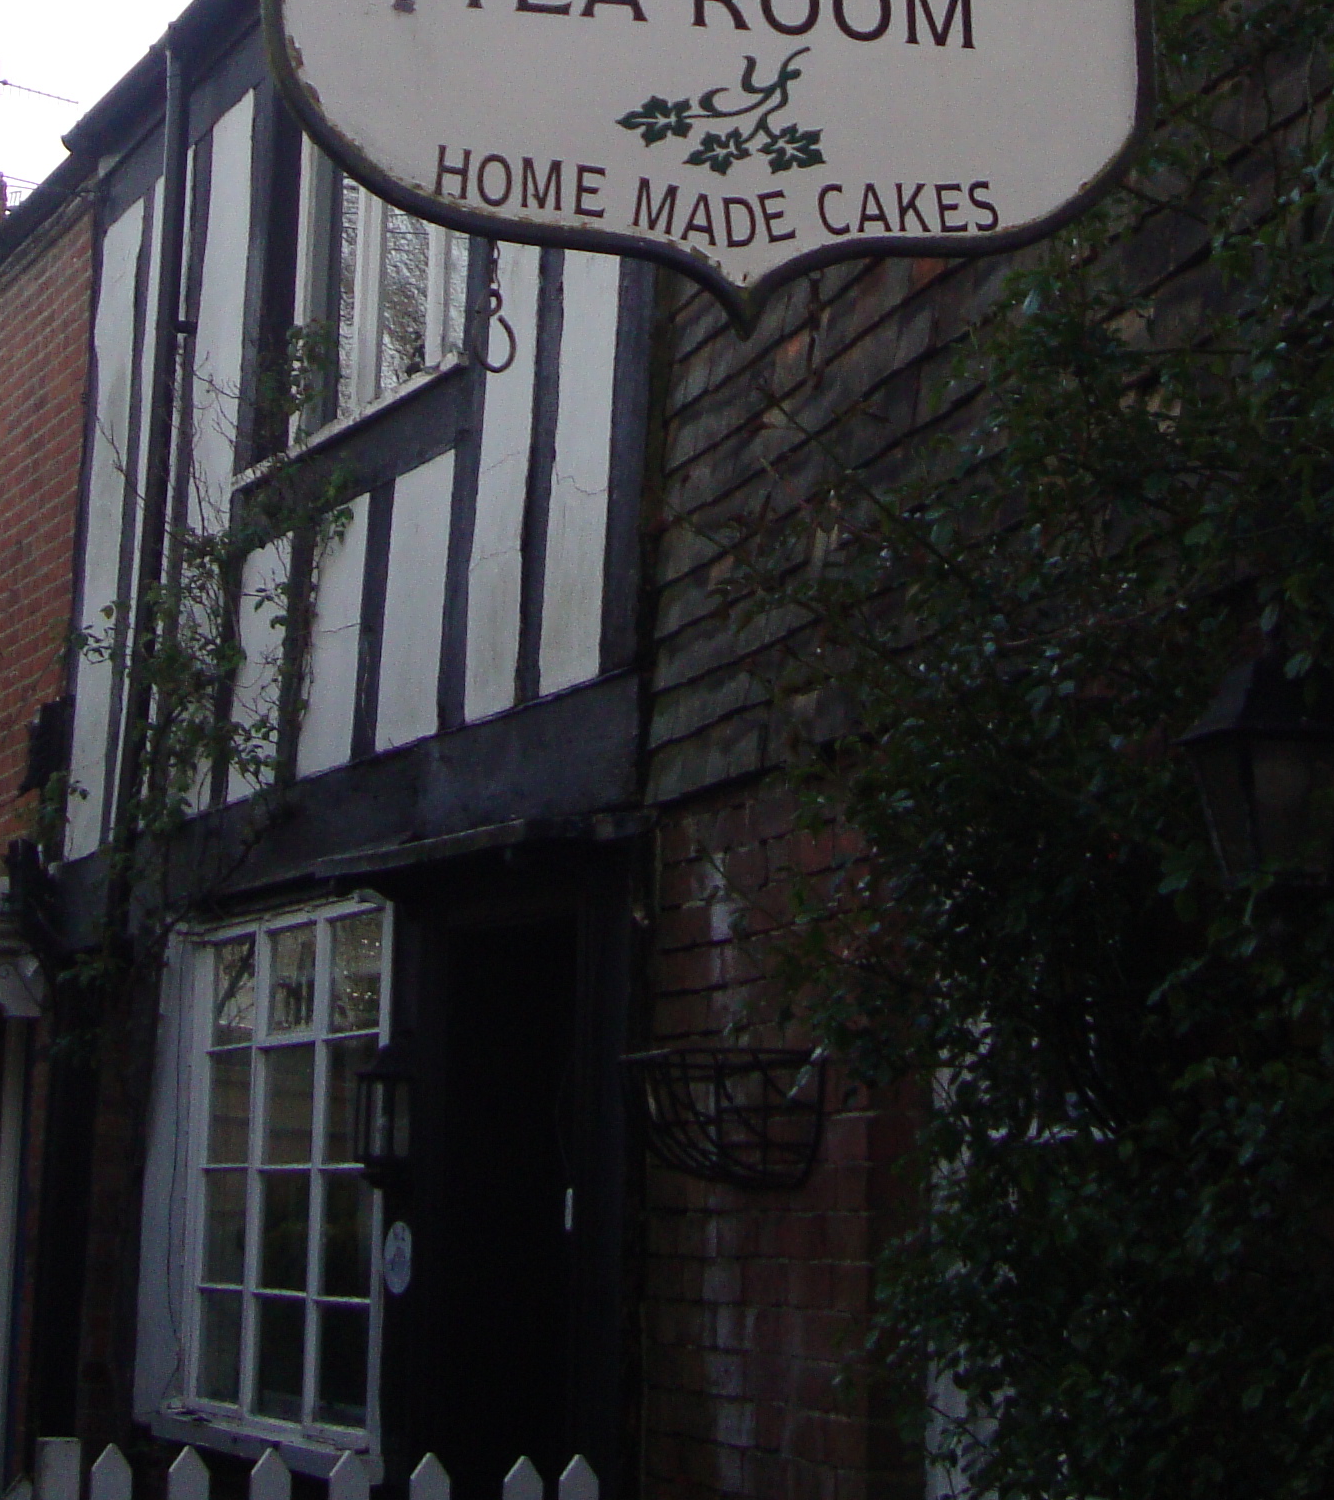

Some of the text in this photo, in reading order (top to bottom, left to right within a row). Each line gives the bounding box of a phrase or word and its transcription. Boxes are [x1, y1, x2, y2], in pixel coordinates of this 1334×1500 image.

[433, 142, 999, 248] HOME MADE CAKES
